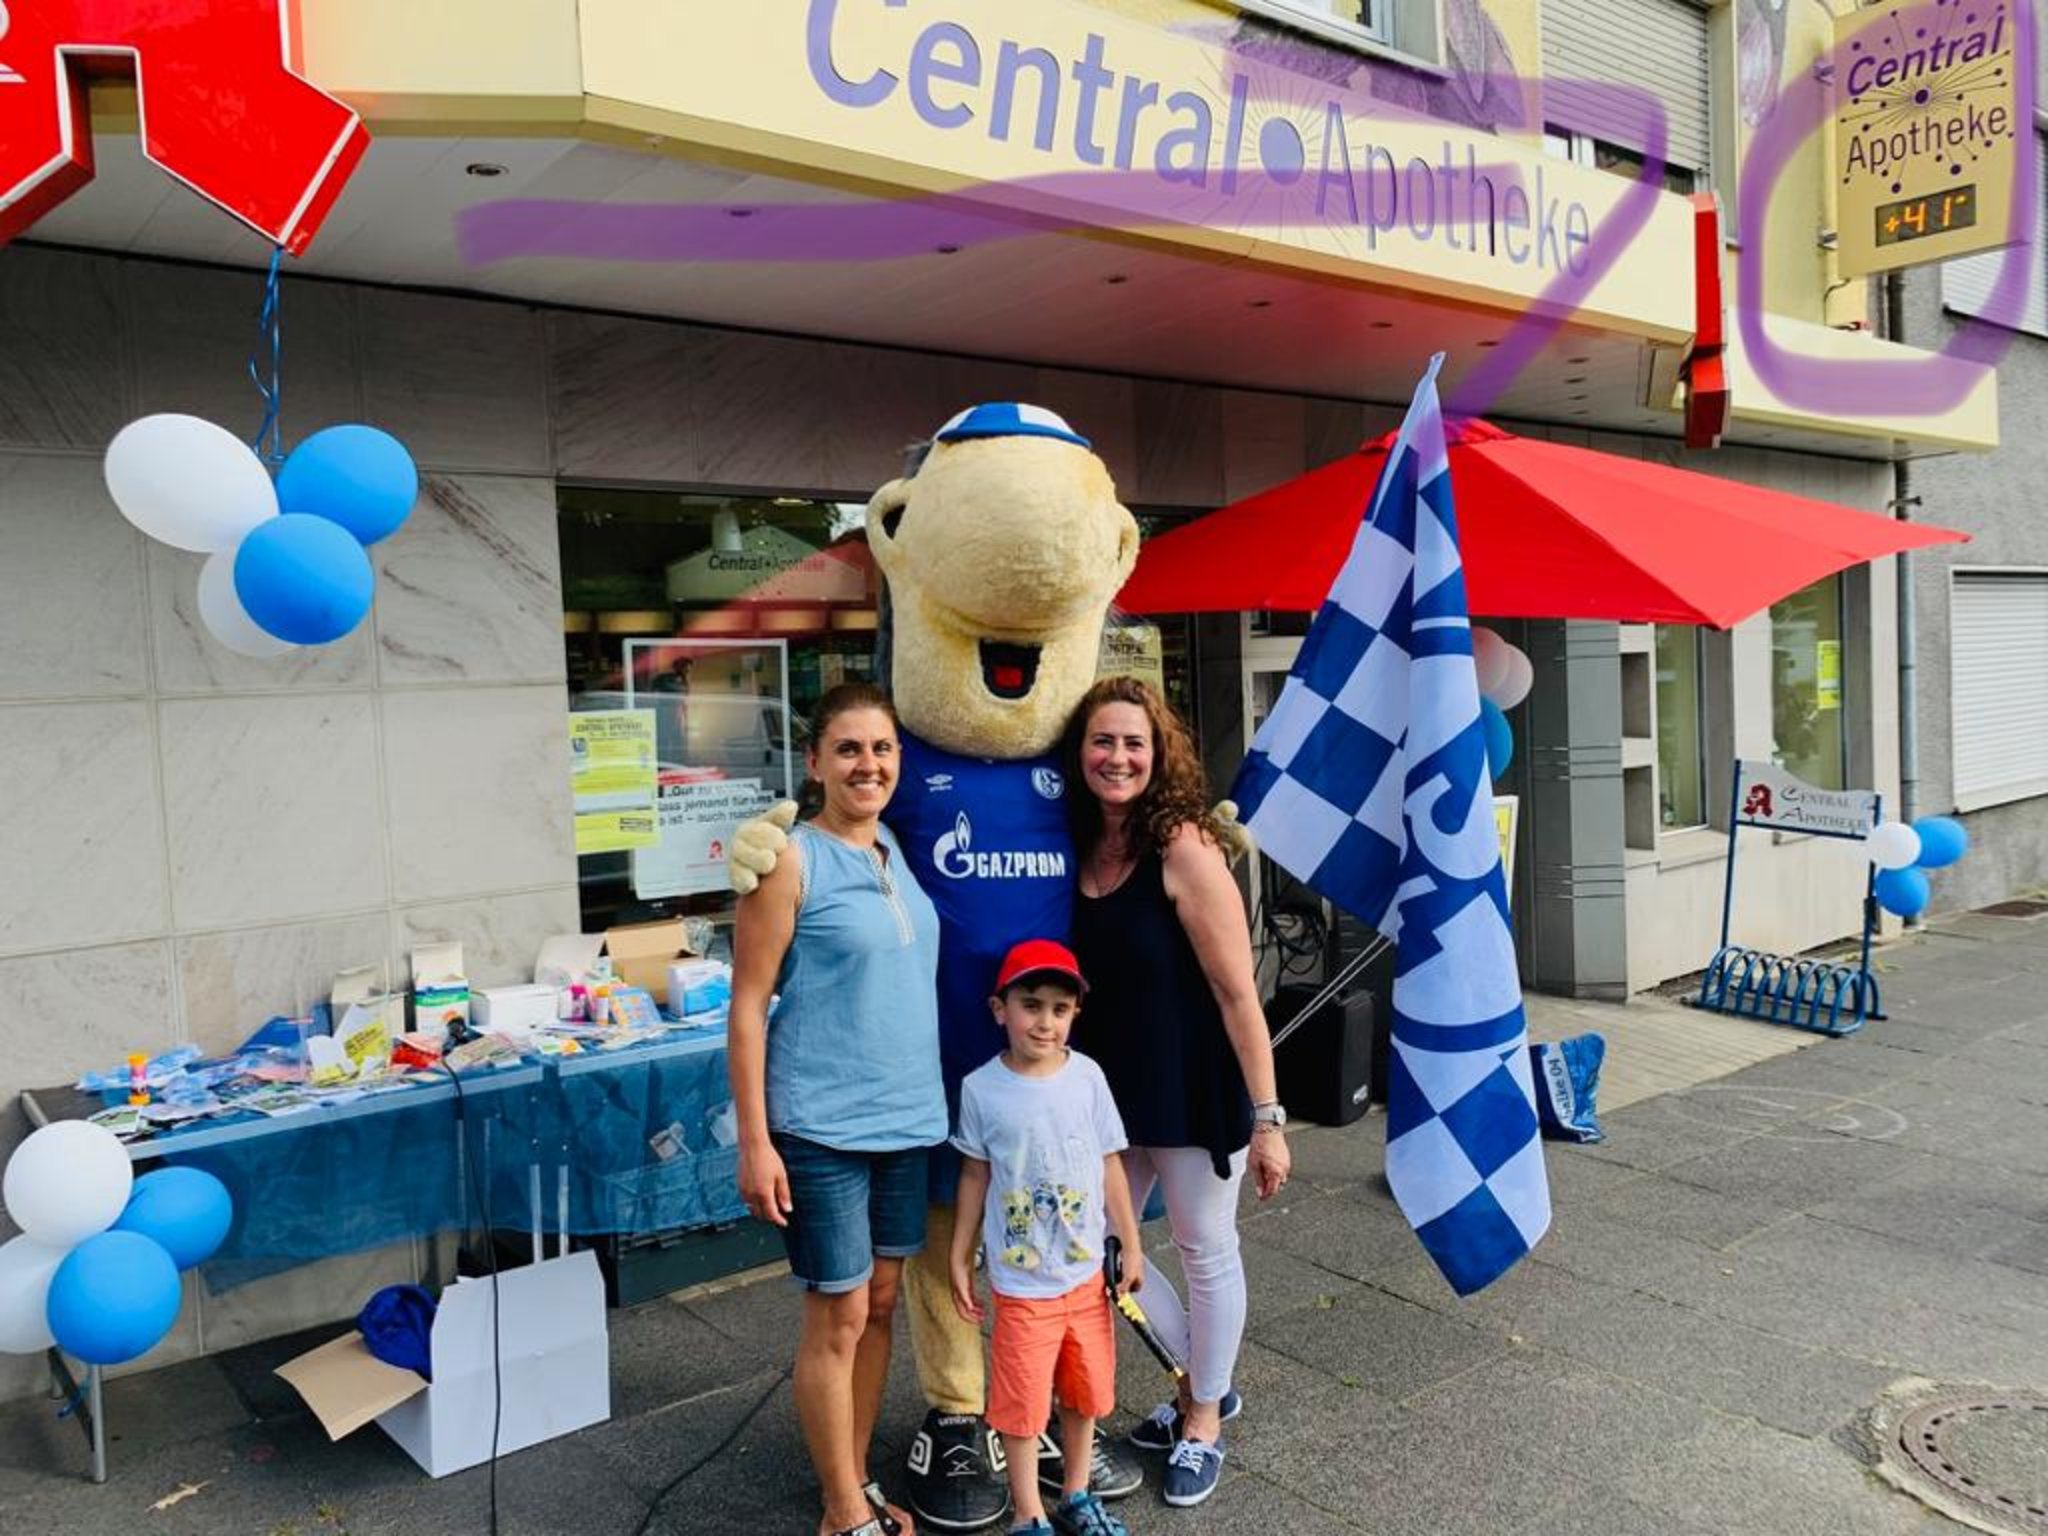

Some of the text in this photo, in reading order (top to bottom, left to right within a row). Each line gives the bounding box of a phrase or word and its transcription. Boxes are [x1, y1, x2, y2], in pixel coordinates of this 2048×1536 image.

[1847, 15, 2005, 97] Central
[806, 0, 1592, 277] Central Apotheke
[1846, 104, 2008, 175] Apotheke
[708, 553, 763, 571] Central
[977, 852, 1066, 879] GAZPROM
[937, 1415, 976, 1426] umbro
